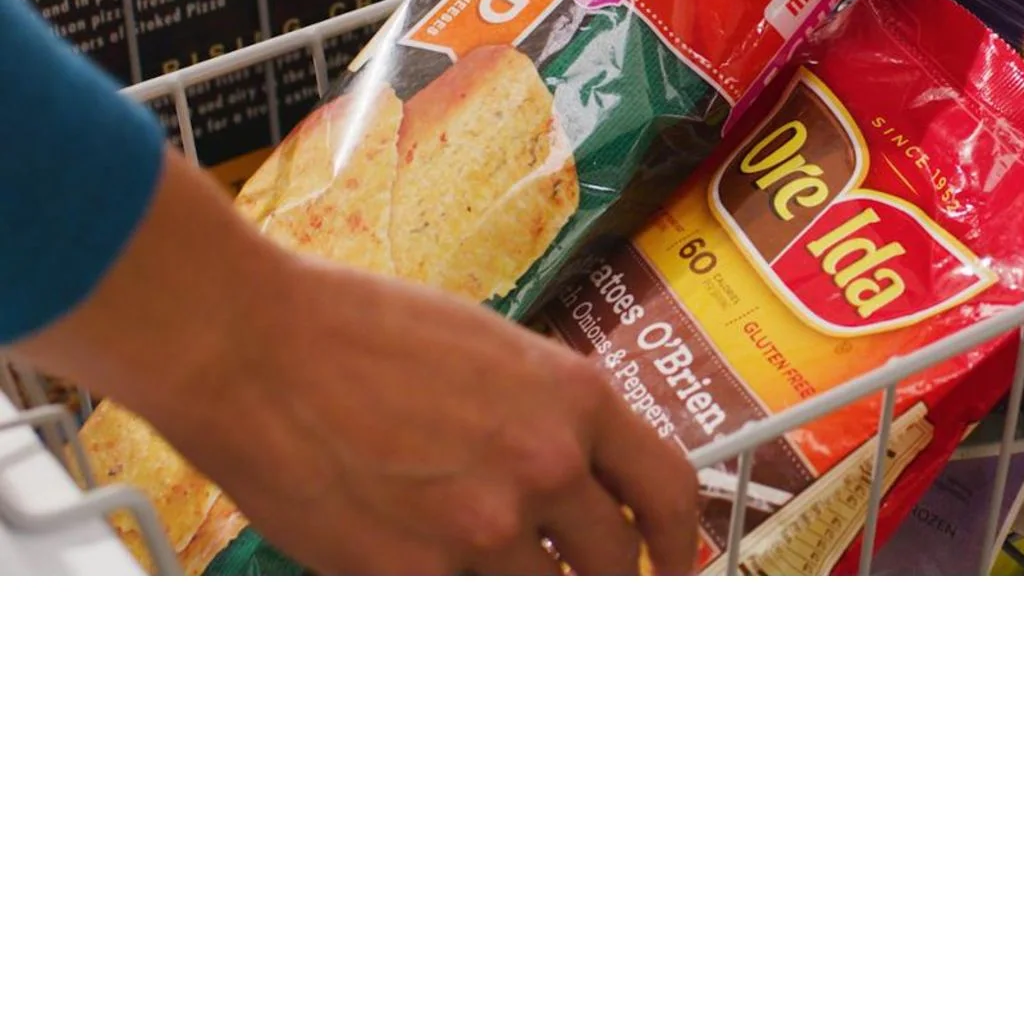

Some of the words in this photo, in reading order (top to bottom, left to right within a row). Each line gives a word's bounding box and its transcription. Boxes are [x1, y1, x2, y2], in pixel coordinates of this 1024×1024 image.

[870, 115, 931, 169] SINCE
[930, 167, 961, 212] 1952
[678, 236, 718, 276] 60
[739, 119, 830, 222] Ore
[806, 206, 908, 320] Ida
[571, 300, 613, 355] Onions
[589, 261, 646, 326] atoes
[636, 320, 727, 435] O'Brien
[606, 347, 628, 371] &
[742, 320, 790, 374] GLUTEN
[783, 361, 818, 402] FREE
[614, 359, 676, 439] Peppers
